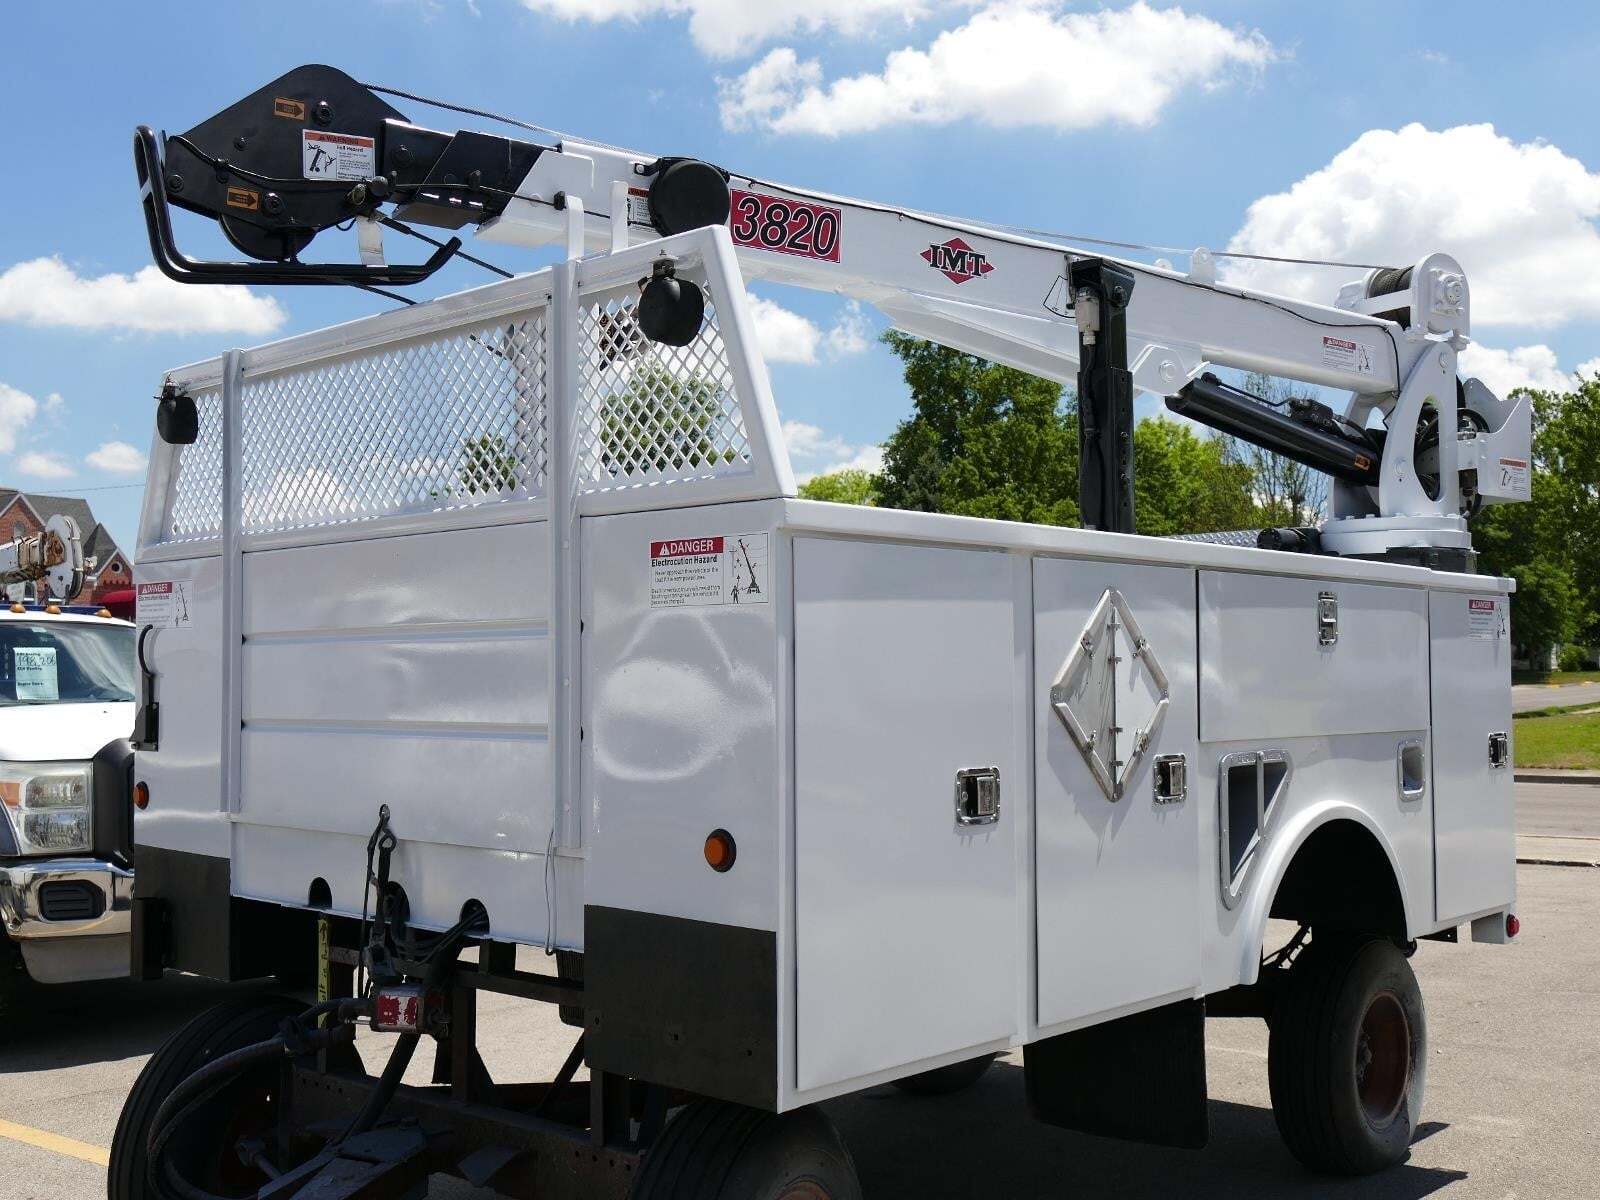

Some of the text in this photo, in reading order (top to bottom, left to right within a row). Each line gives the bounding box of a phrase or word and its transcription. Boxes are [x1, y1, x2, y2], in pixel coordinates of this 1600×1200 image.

[734, 196, 838, 257] 3820
[929, 244, 986, 277] IMT
[670, 540, 714, 554] DANGER
[651, 555, 718, 567] Electrocution Hazard
[147, 583, 168, 593] DANGER
[1475, 600, 1492, 609] DANGER
